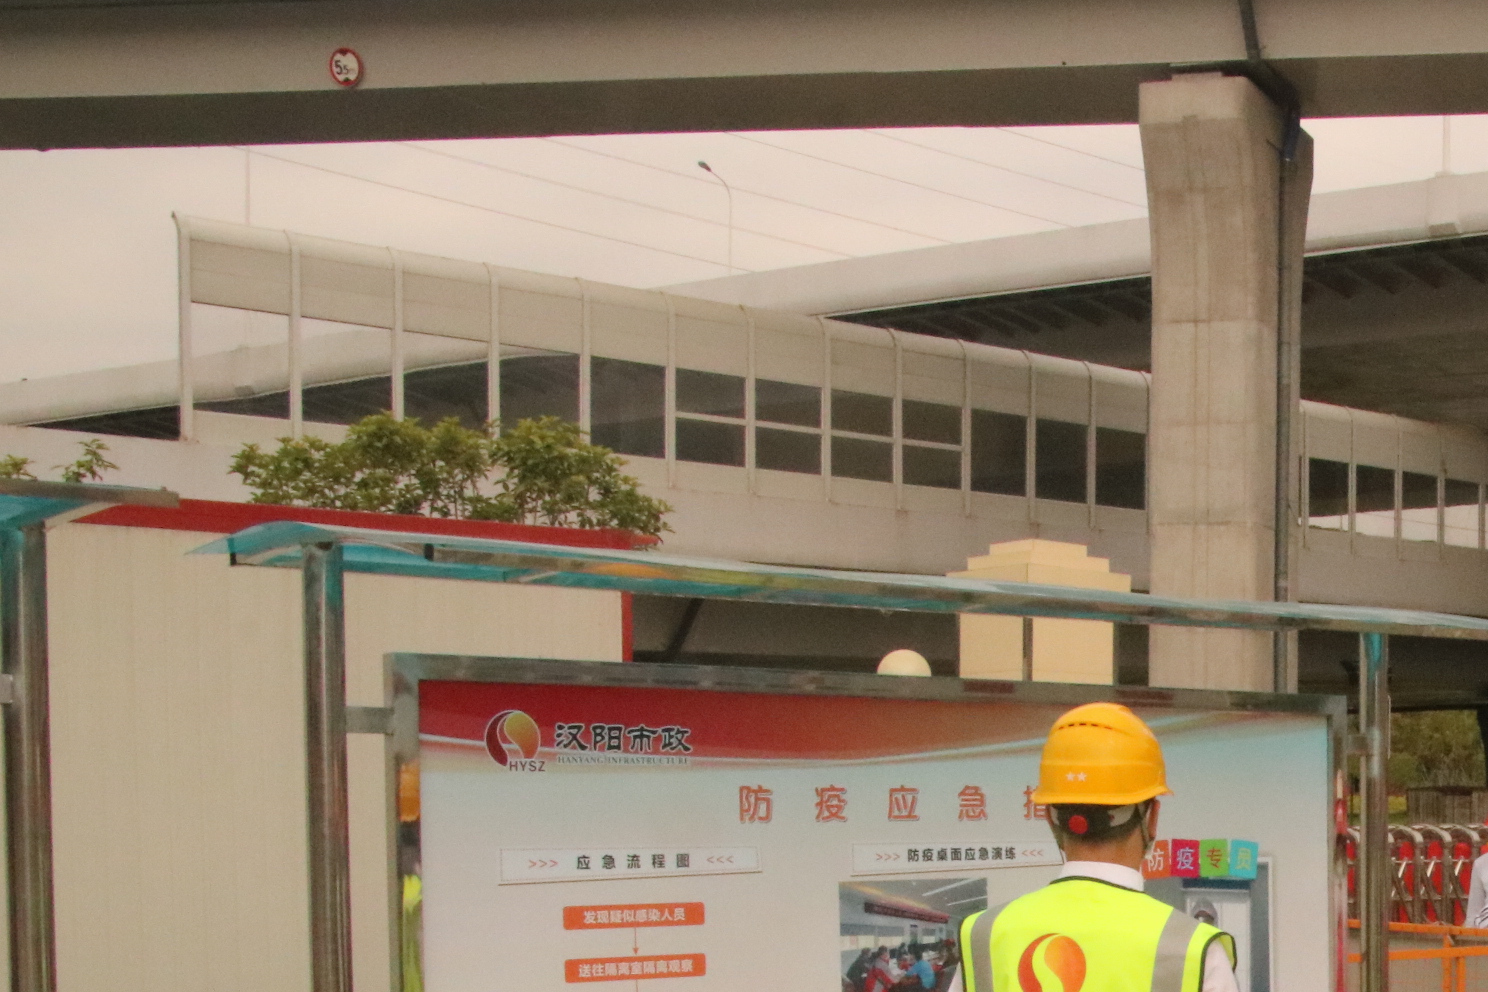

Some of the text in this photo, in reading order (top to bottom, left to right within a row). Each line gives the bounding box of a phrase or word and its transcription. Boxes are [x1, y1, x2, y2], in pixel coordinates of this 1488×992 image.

[555, 724, 692, 752] 汉阳市政
[509, 760, 546, 772] HYSZ
[558, 756, 604, 764] HANYANG
[576, 853, 690, 870] 应急流程图
[907, 846, 1016, 862] 防疫桌面应急演练
[1148, 846, 1252, 871] 防疫专员
[583, 908, 686, 925] 发现疑似感染人员
[578, 959, 694, 978] 送往隔离室隔离观察
